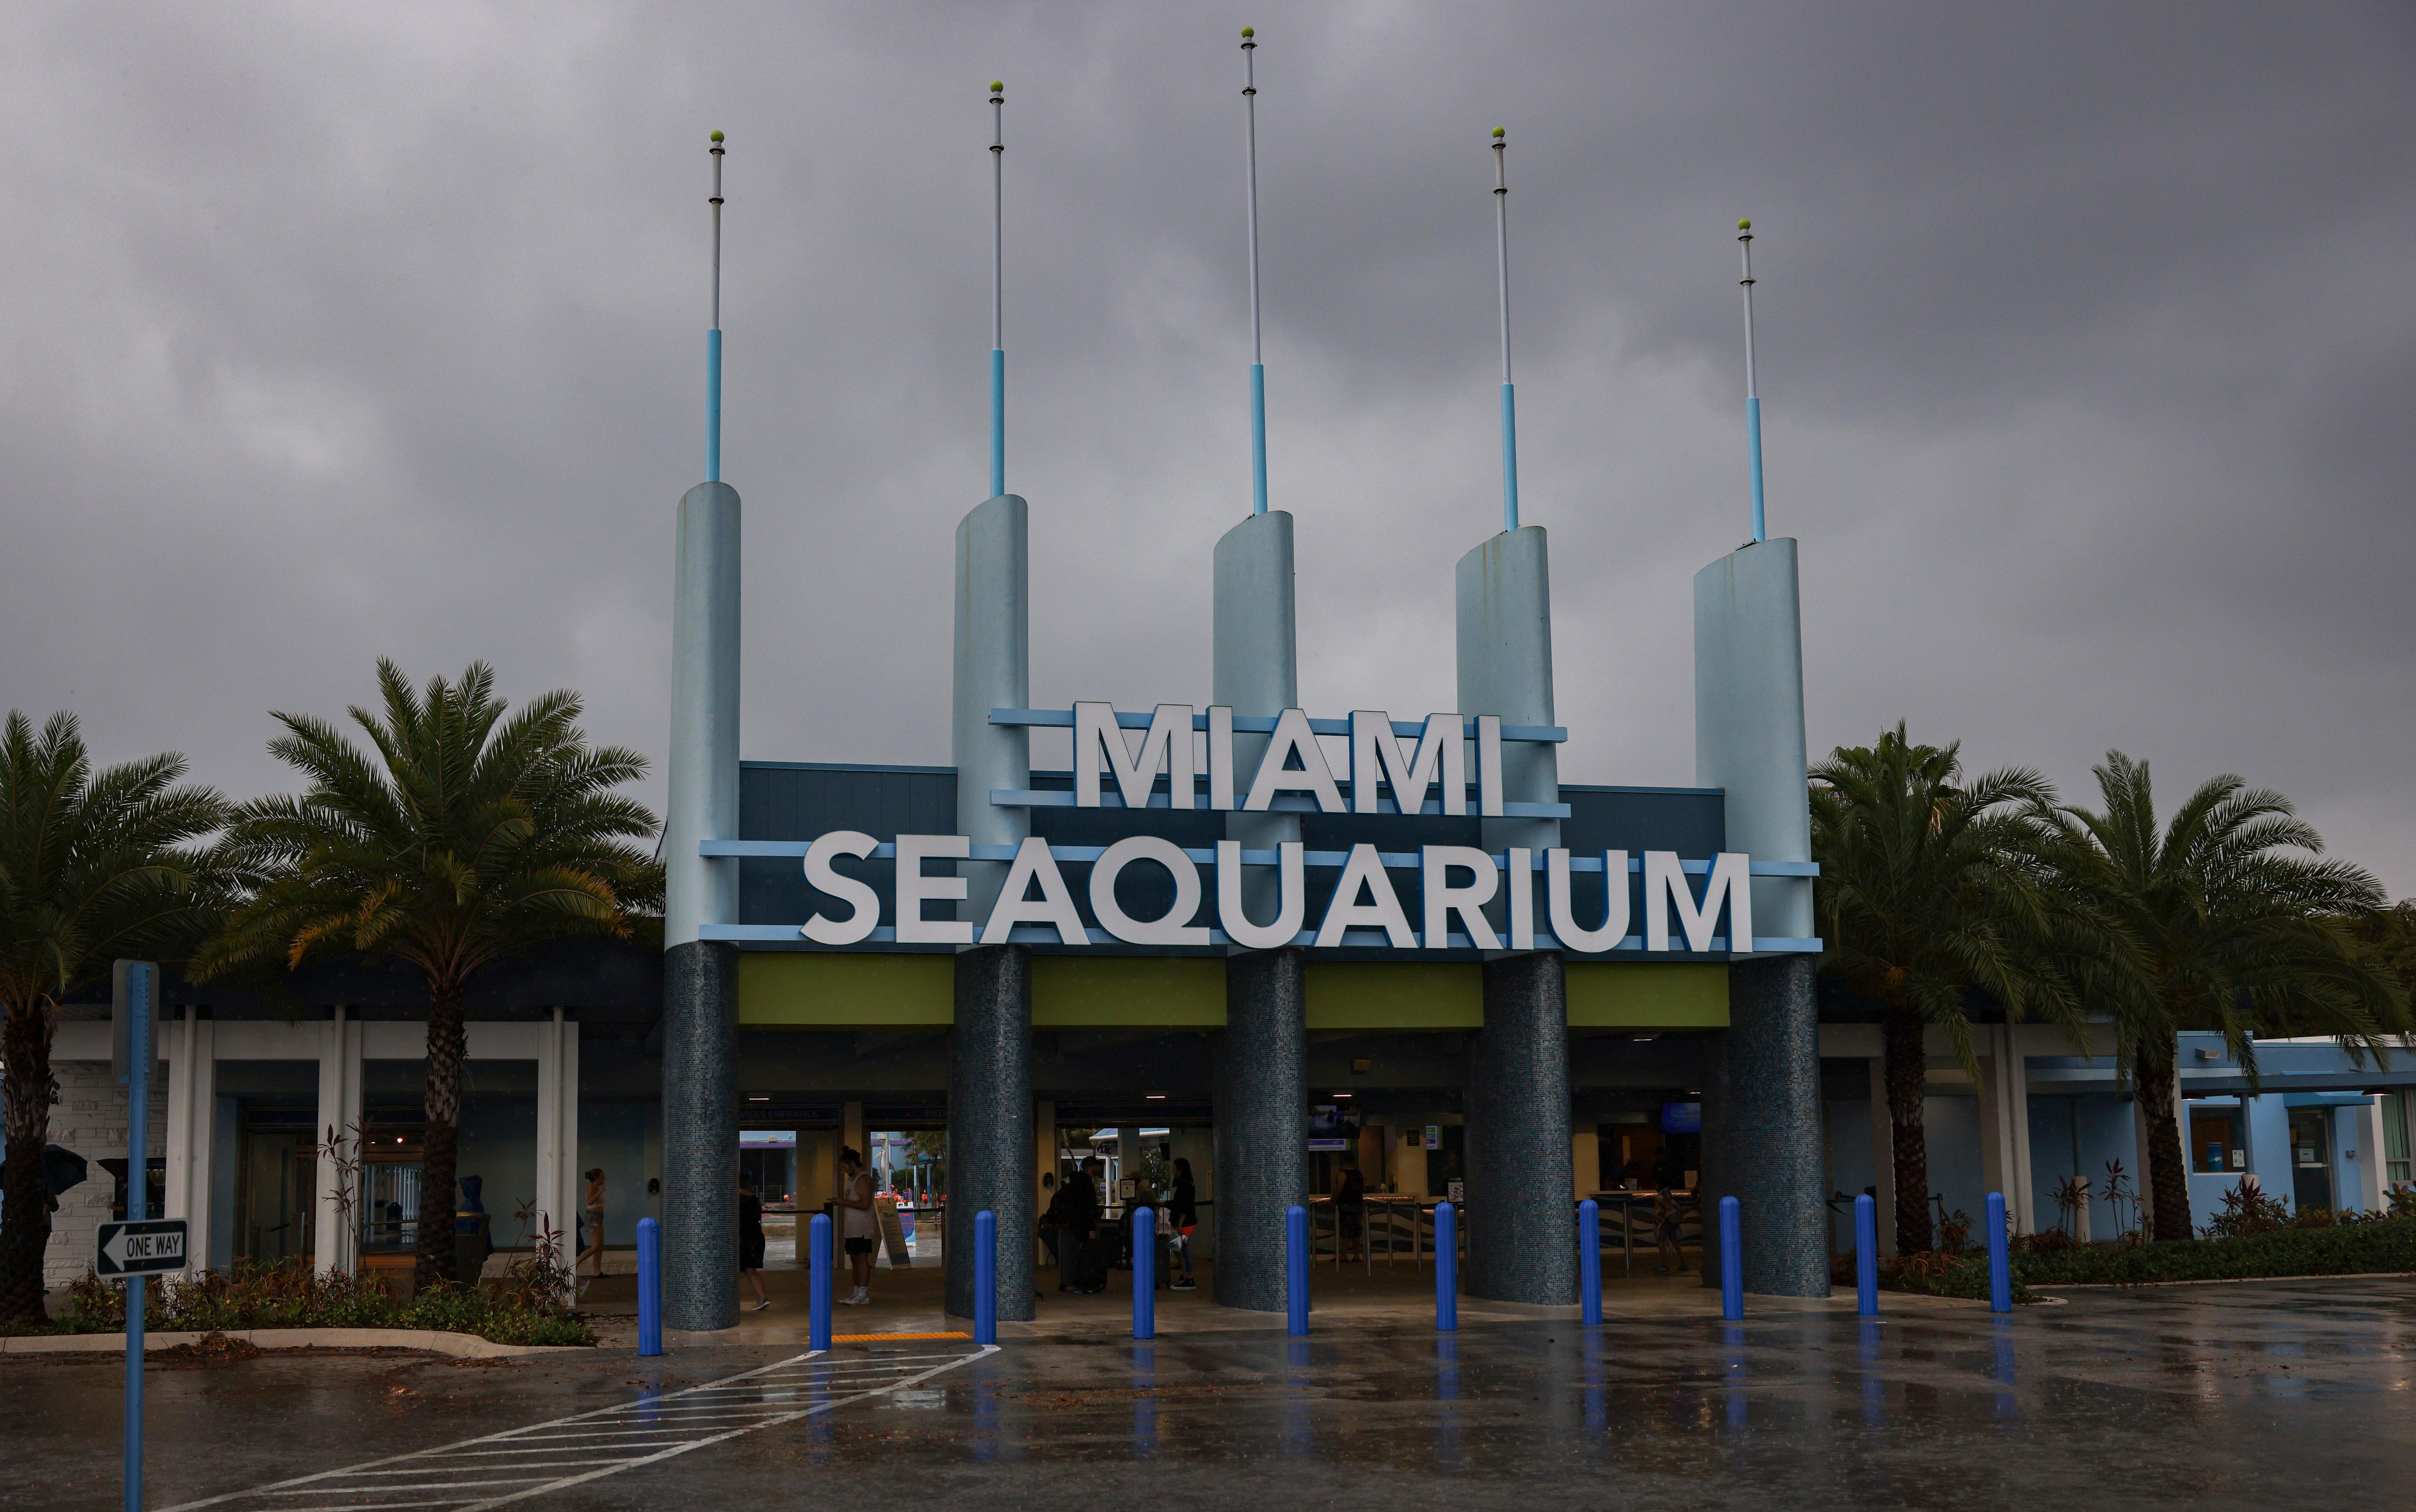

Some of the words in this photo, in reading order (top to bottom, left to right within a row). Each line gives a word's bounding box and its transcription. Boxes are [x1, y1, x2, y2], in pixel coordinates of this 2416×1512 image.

[1073, 702, 1503, 817] MIAMI
[800, 830, 1753, 953] SEAQUARIUM
[740, 1110, 766, 1118] VICES
[768, 1110, 819, 1118] ENTRANCE
[127, 1237, 151, 1257] ONE
[156, 1235, 180, 1255] WAY
